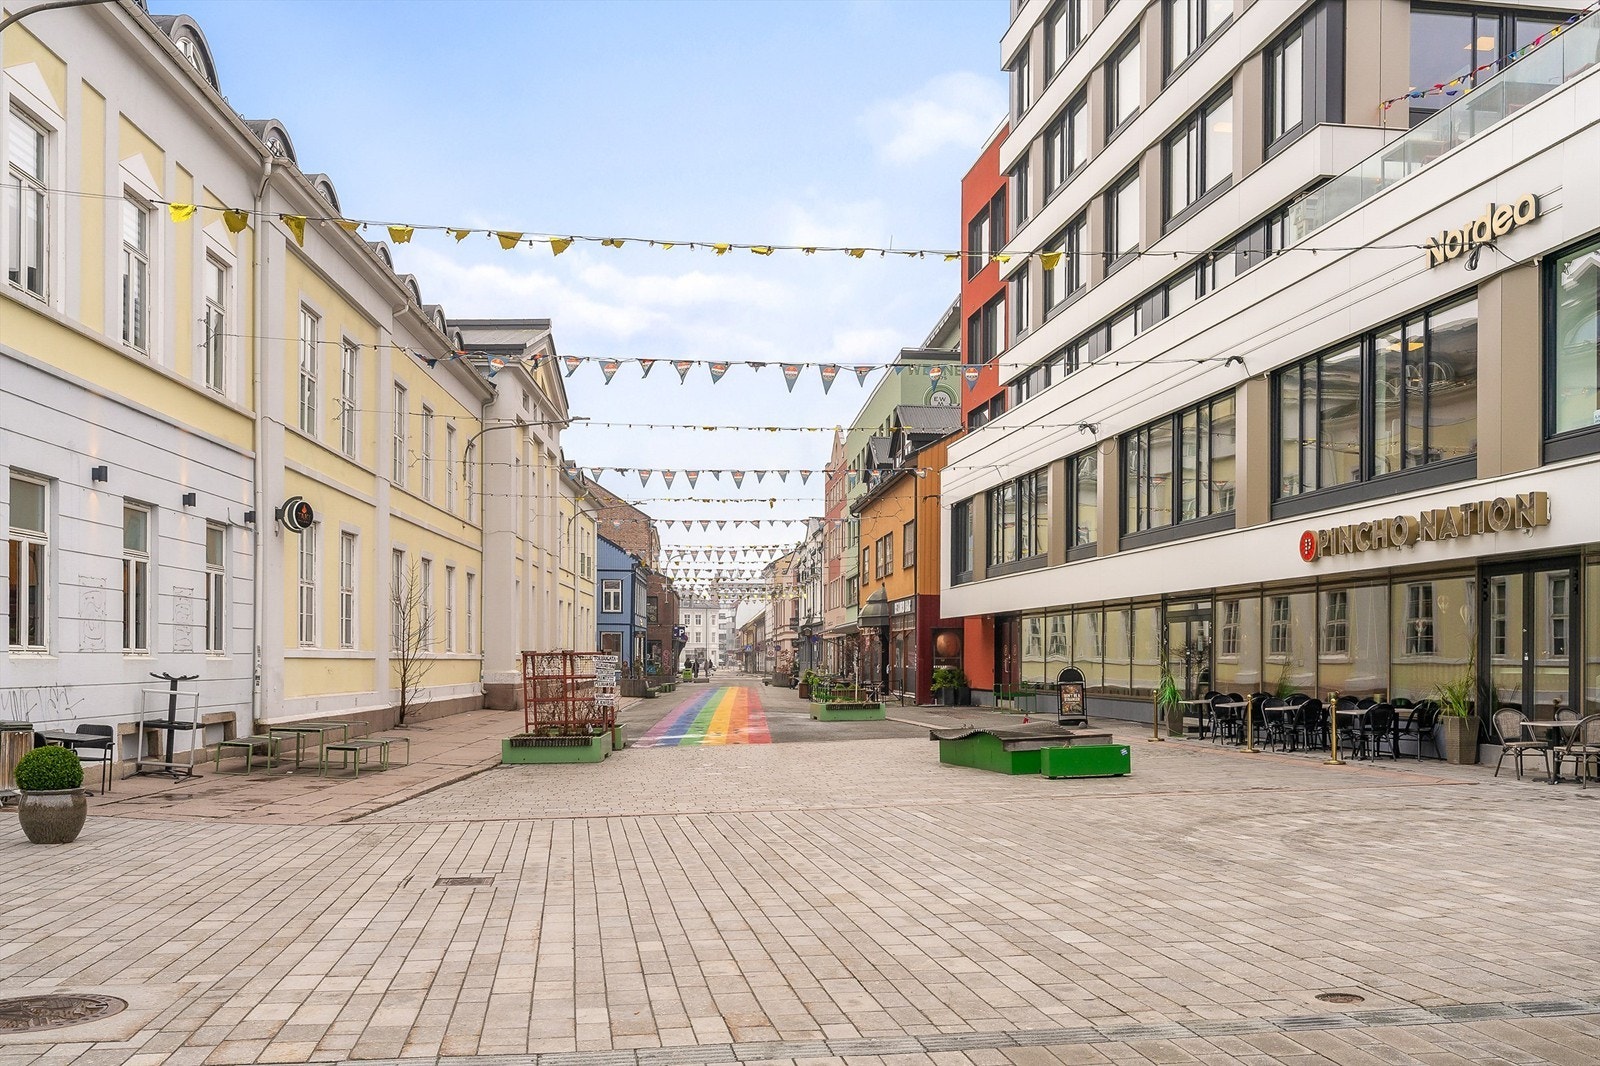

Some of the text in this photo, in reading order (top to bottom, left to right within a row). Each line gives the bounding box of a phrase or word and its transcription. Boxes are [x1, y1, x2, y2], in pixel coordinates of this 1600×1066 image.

[1425, 193, 1539, 269] Nordea
[1317, 515, 1411, 558] PINCHO
[1419, 491, 1541, 542] NATION
